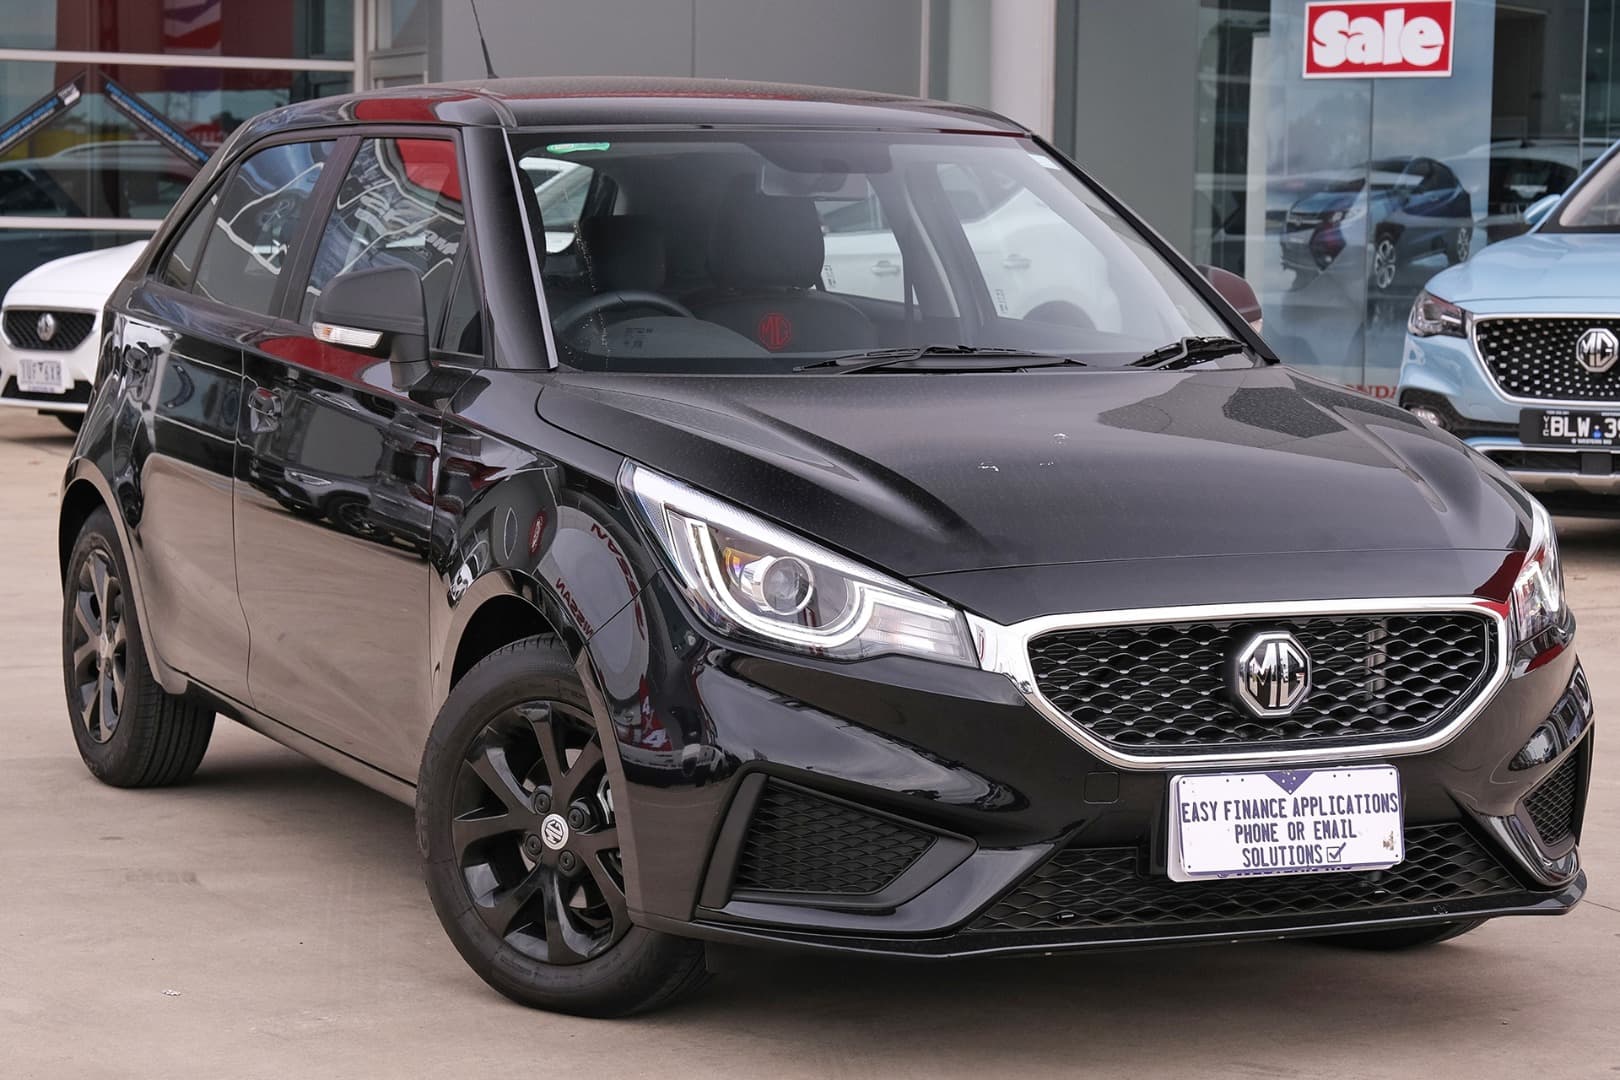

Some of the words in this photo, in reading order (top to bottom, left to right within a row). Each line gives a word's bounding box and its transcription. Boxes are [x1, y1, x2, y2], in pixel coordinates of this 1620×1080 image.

[1312, 8, 1445, 68] Sale
[1579, 331, 1614, 368] MG
[1550, 416, 1591, 437] BLW
[1247, 640, 1306, 708] MG
[1182, 801, 1218, 823] EASY
[1224, 798, 1288, 821] FINANCE
[1292, 793, 1398, 817] APPLICATIONS
[1234, 823, 1278, 844] PHONE
[1287, 821, 1305, 841] OR
[1314, 818, 1357, 841] EMAIL
[1242, 845, 1323, 868] SOLUTIONS
